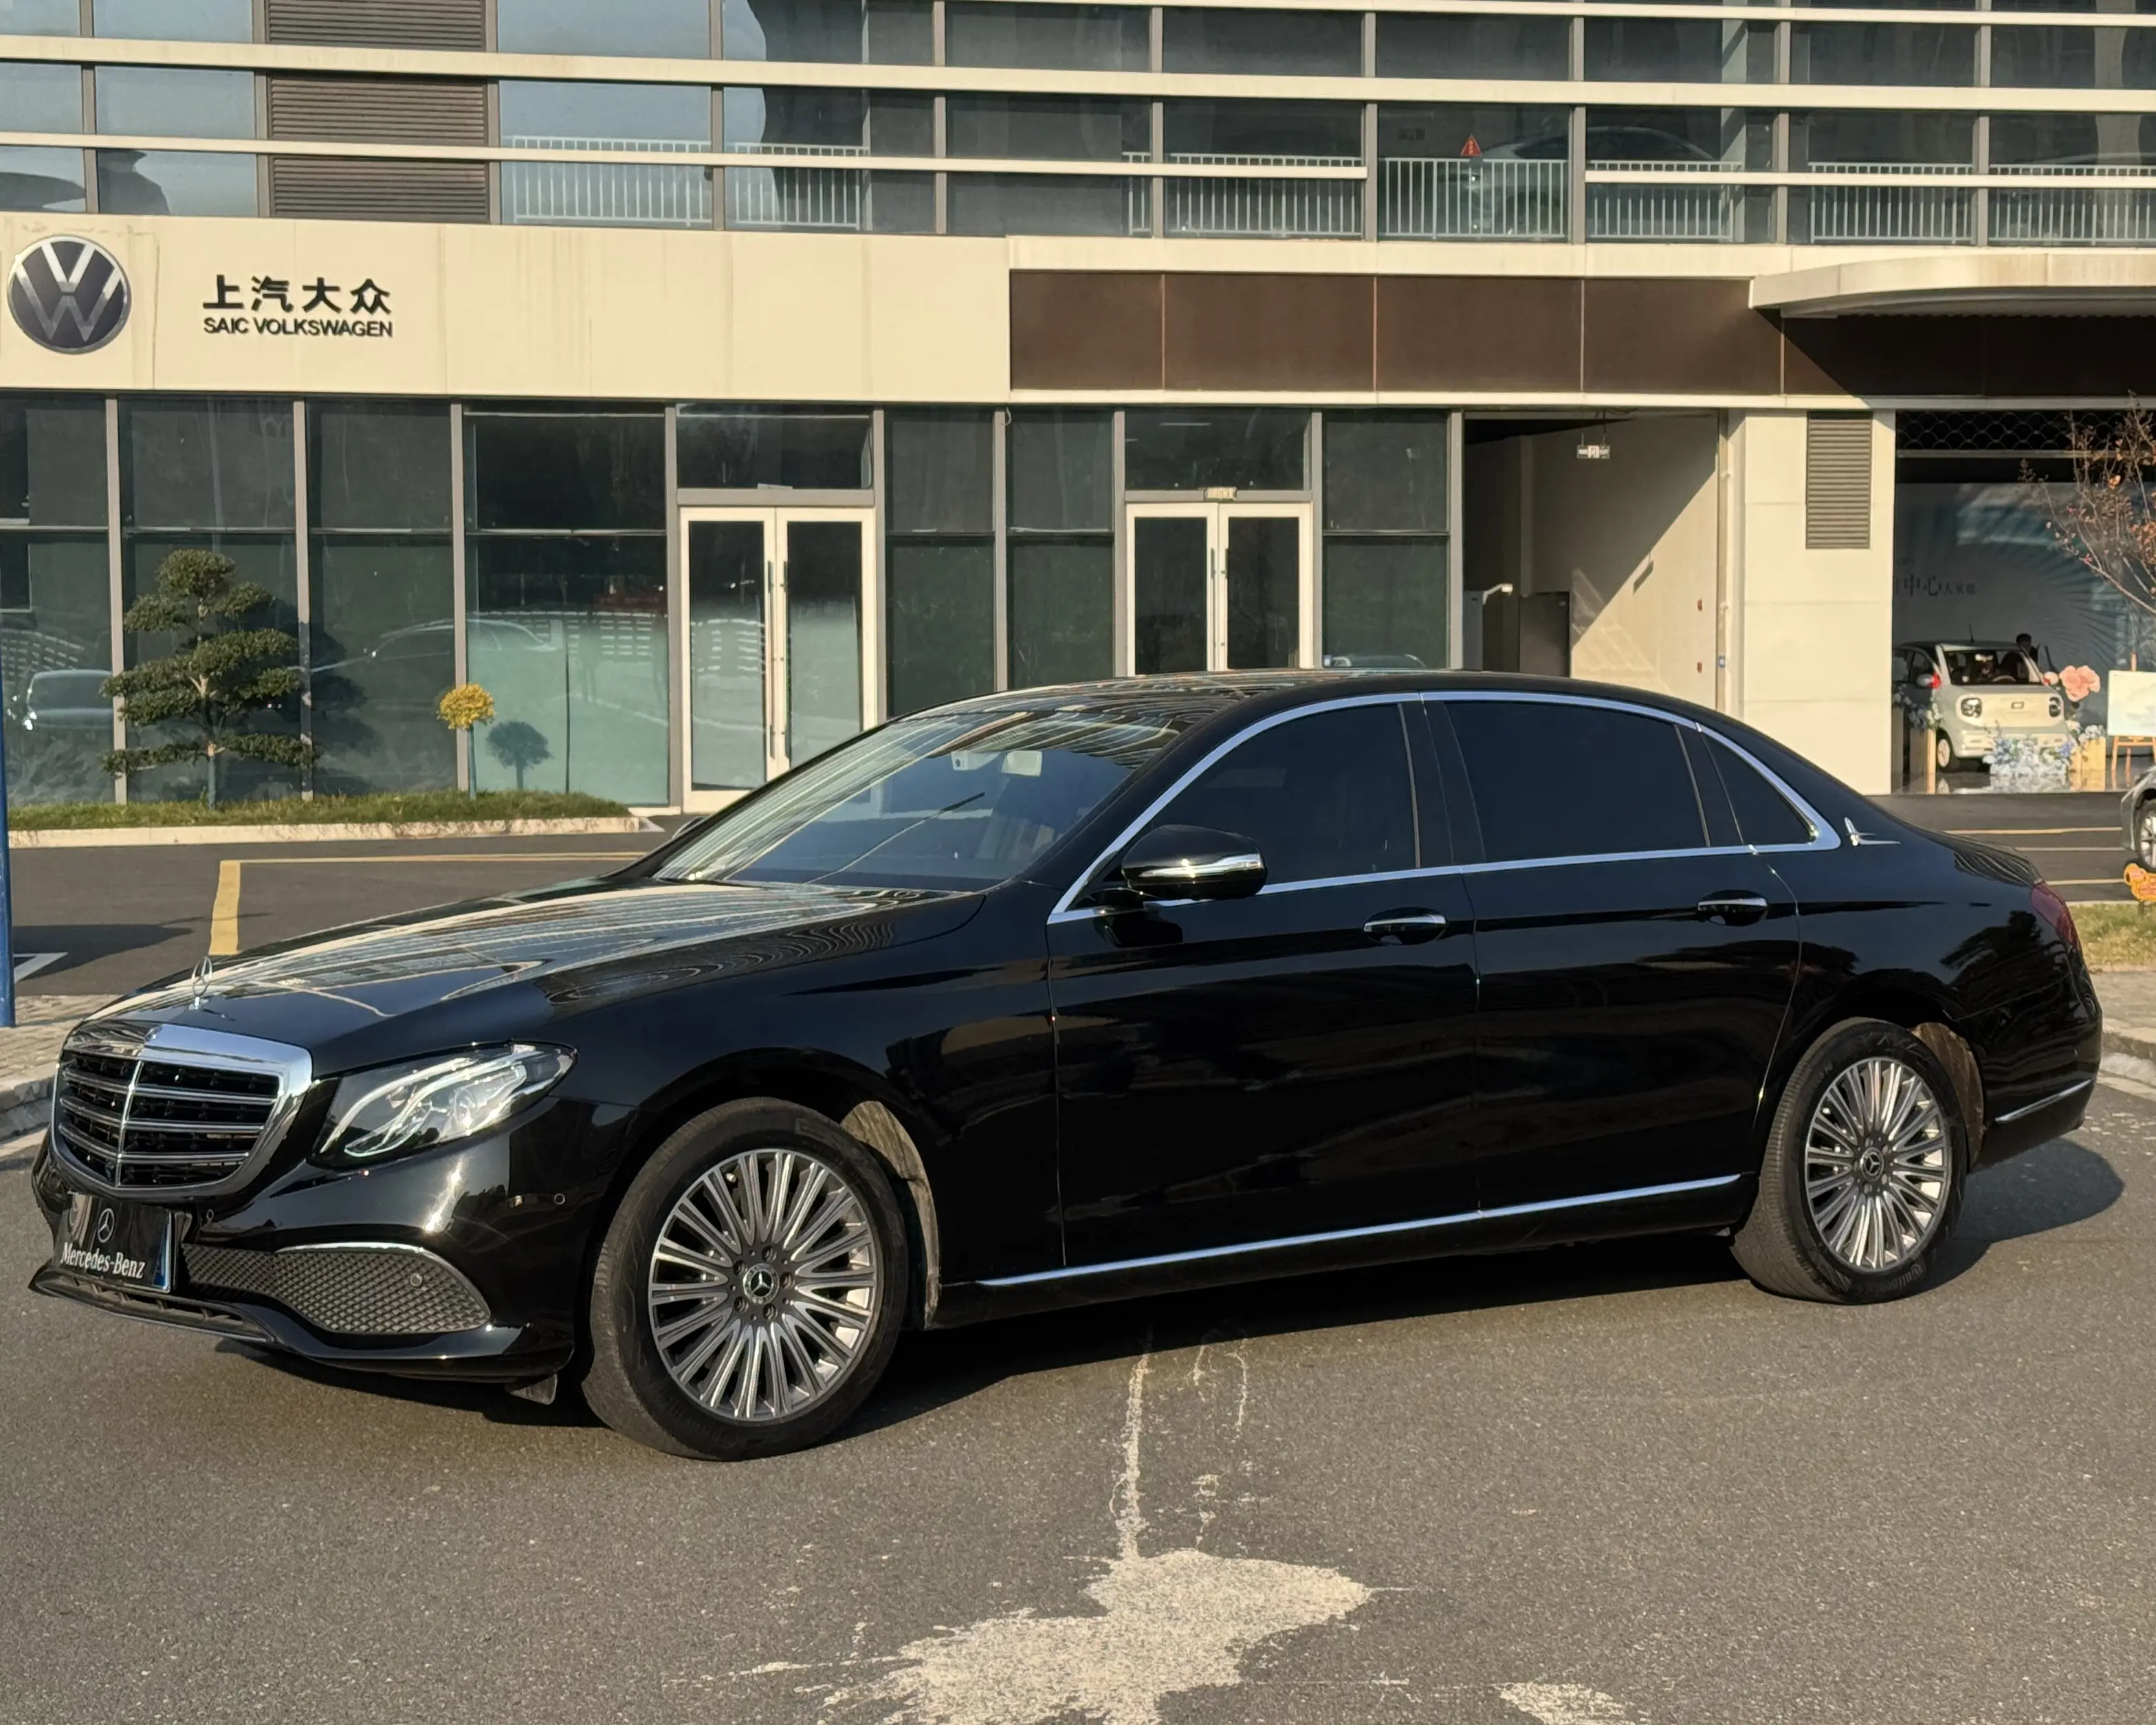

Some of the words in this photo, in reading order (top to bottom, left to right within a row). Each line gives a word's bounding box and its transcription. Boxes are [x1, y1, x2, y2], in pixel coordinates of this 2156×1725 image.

[203, 274, 391, 314] 上汽大众
[204, 317, 249, 334] SAIC
[253, 318, 393, 337] VOLKSWAGEN
[60, 1242, 146, 1279] Mercedes-Benz
